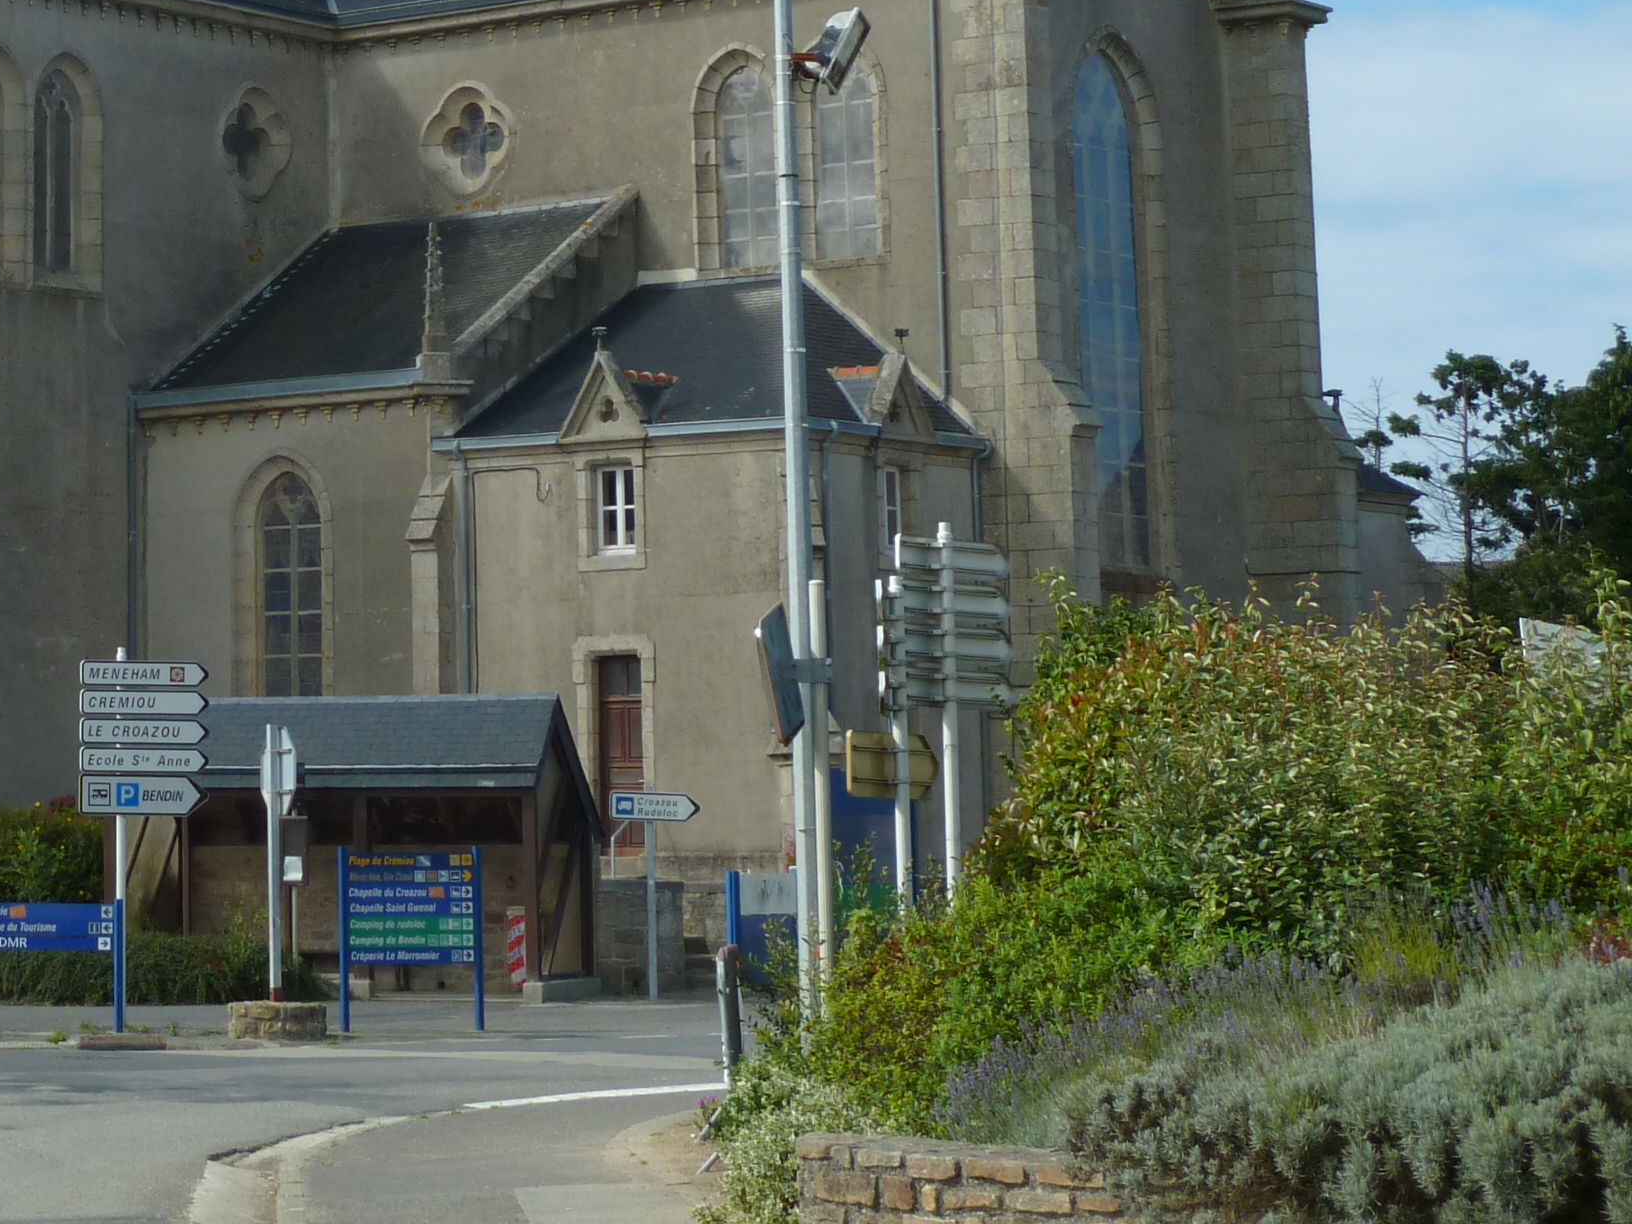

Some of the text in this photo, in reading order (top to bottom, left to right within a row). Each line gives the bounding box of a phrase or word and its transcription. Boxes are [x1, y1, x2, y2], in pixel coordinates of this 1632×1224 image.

[88, 667, 161, 680] MENEHAM
[88, 696, 156, 708] CREMIOU
[88, 725, 181, 738] LE CROAZOU
[88, 754, 124, 766] Ecole
[157, 755, 191, 767] Anne
[141, 789, 184, 802] BENDIN
[637, 797, 678, 807] Croazou
[637, 807, 678, 817] Rudoloc
[348, 855, 370, 867] Plage
[372, 855, 382, 865] du
[348, 887, 427, 899] Chapelle du Croazou
[350, 902, 384, 914] Chapelle
[385, 902, 406, 912] Saint
[7, 922, 18, 932] du
[20, 922, 57, 932] Tourisme
[349, 919, 384, 930] Camping
[349, 935, 426, 946] Camping du Bendin
[386, 950, 396, 960] Le
